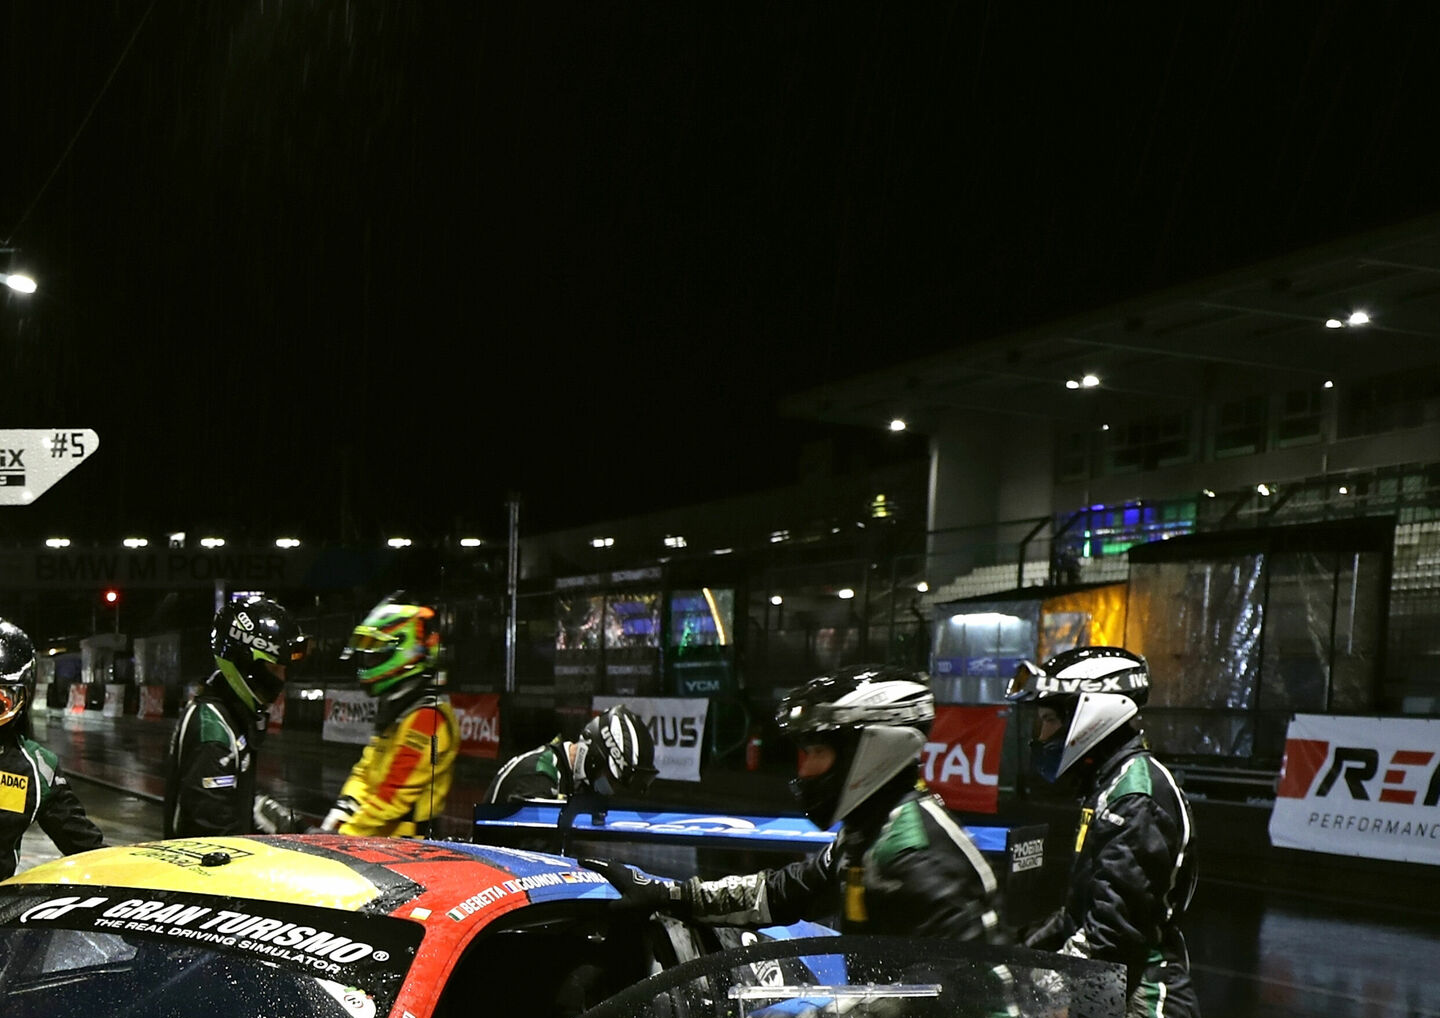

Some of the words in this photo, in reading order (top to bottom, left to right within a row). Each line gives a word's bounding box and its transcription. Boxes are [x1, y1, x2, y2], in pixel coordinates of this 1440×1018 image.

[50, 432, 85, 458] #5
[229, 626, 281, 655] uvex
[646, 714, 699, 748] MUS
[601, 726, 628, 771] uvex
[923, 742, 999, 786] TAL
[0, 774, 27, 790] ADAC
[462, 886, 508, 915] BERETTA
[517, 873, 560, 893] GOUNON
[102, 898, 203, 928] GRAN
[94, 918, 123, 931] THE
[125, 920, 166, 936] REAL
[167, 925, 238, 948] DRIVING
[237, 938, 343, 975] SIMULATOR
